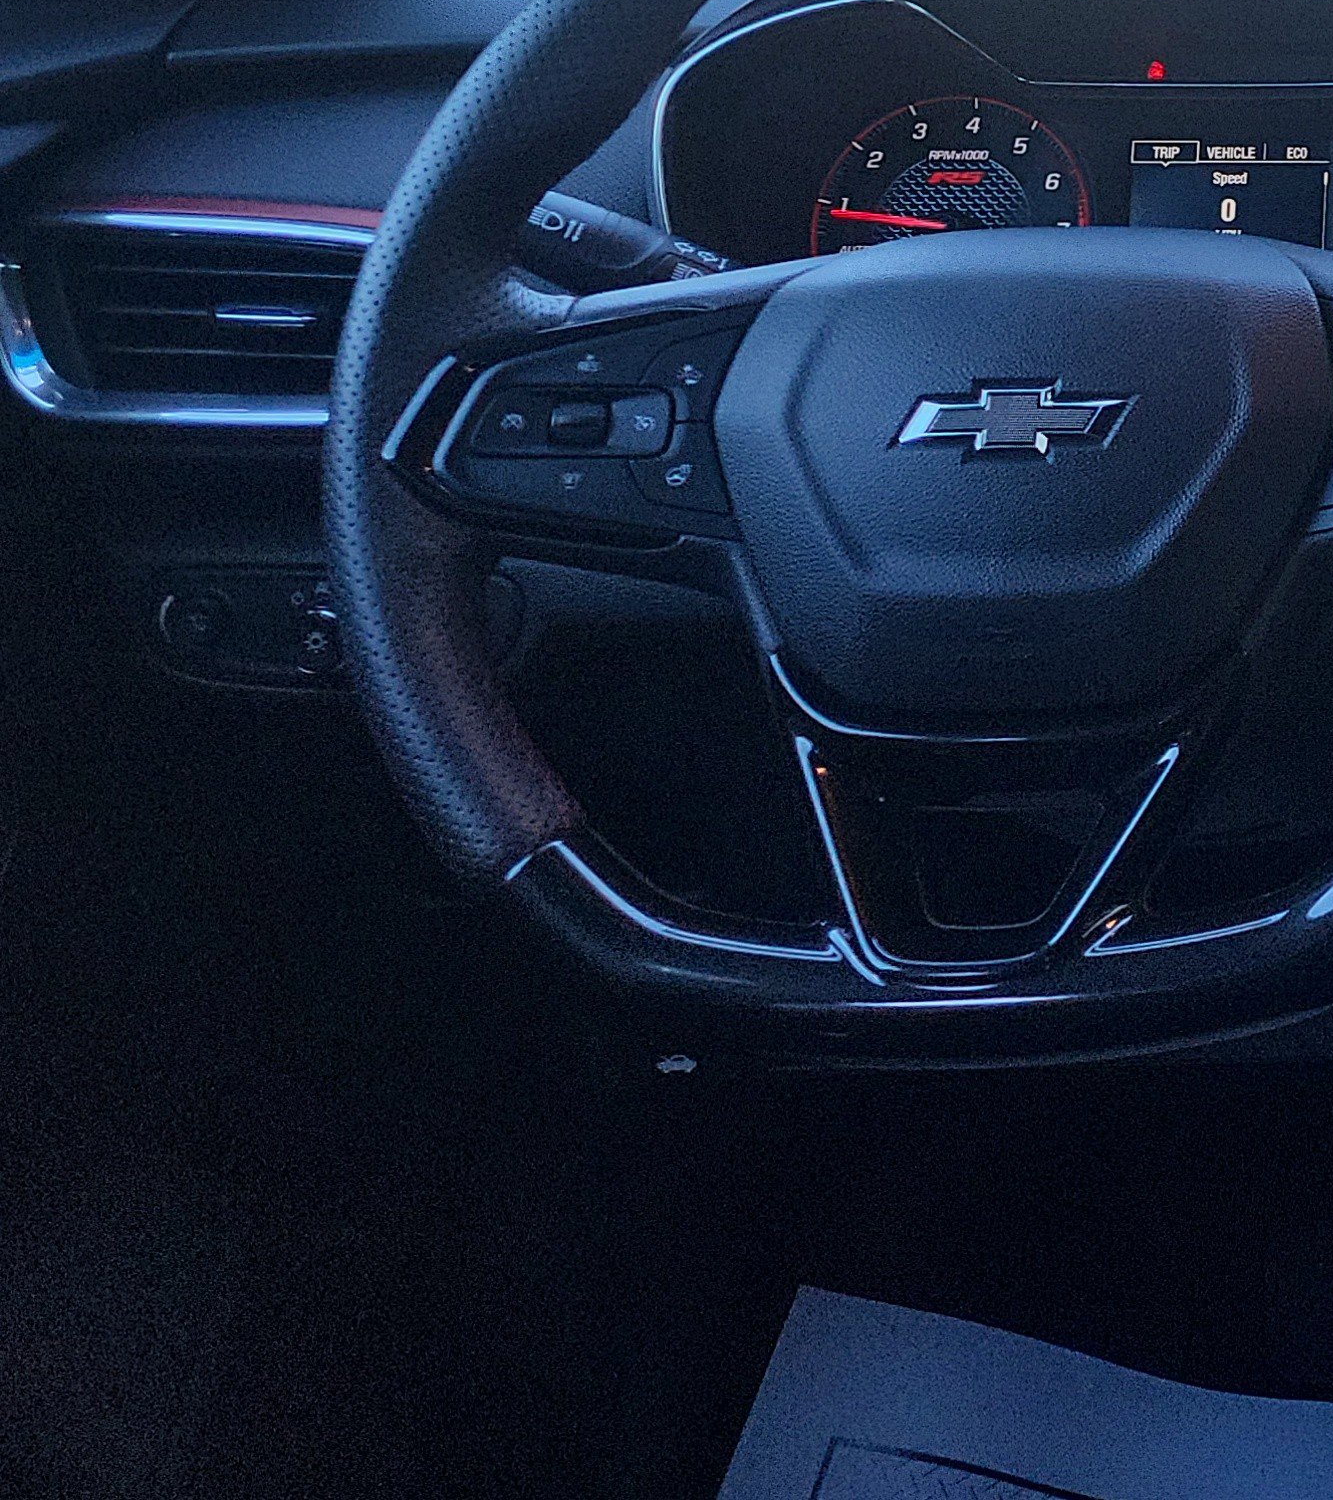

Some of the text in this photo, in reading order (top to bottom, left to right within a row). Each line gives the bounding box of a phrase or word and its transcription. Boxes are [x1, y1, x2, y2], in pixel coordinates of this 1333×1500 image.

[912, 122, 928, 139] 3
[965, 117, 981, 134] 4
[1013, 137, 1030, 154] 5
[1152, 146, 1180, 159] TRIP
[1206, 146, 1256, 159] VEHICLE
[1286, 147, 1308, 159] ECO
[866, 151, 884, 168] 2
[929, 150, 989, 161] RPMx1000
[926, 171, 987, 185] RS
[1045, 173, 1061, 190] 6
[1212, 171, 1248, 187] Speed
[1220, 198, 1236, 222] 0
